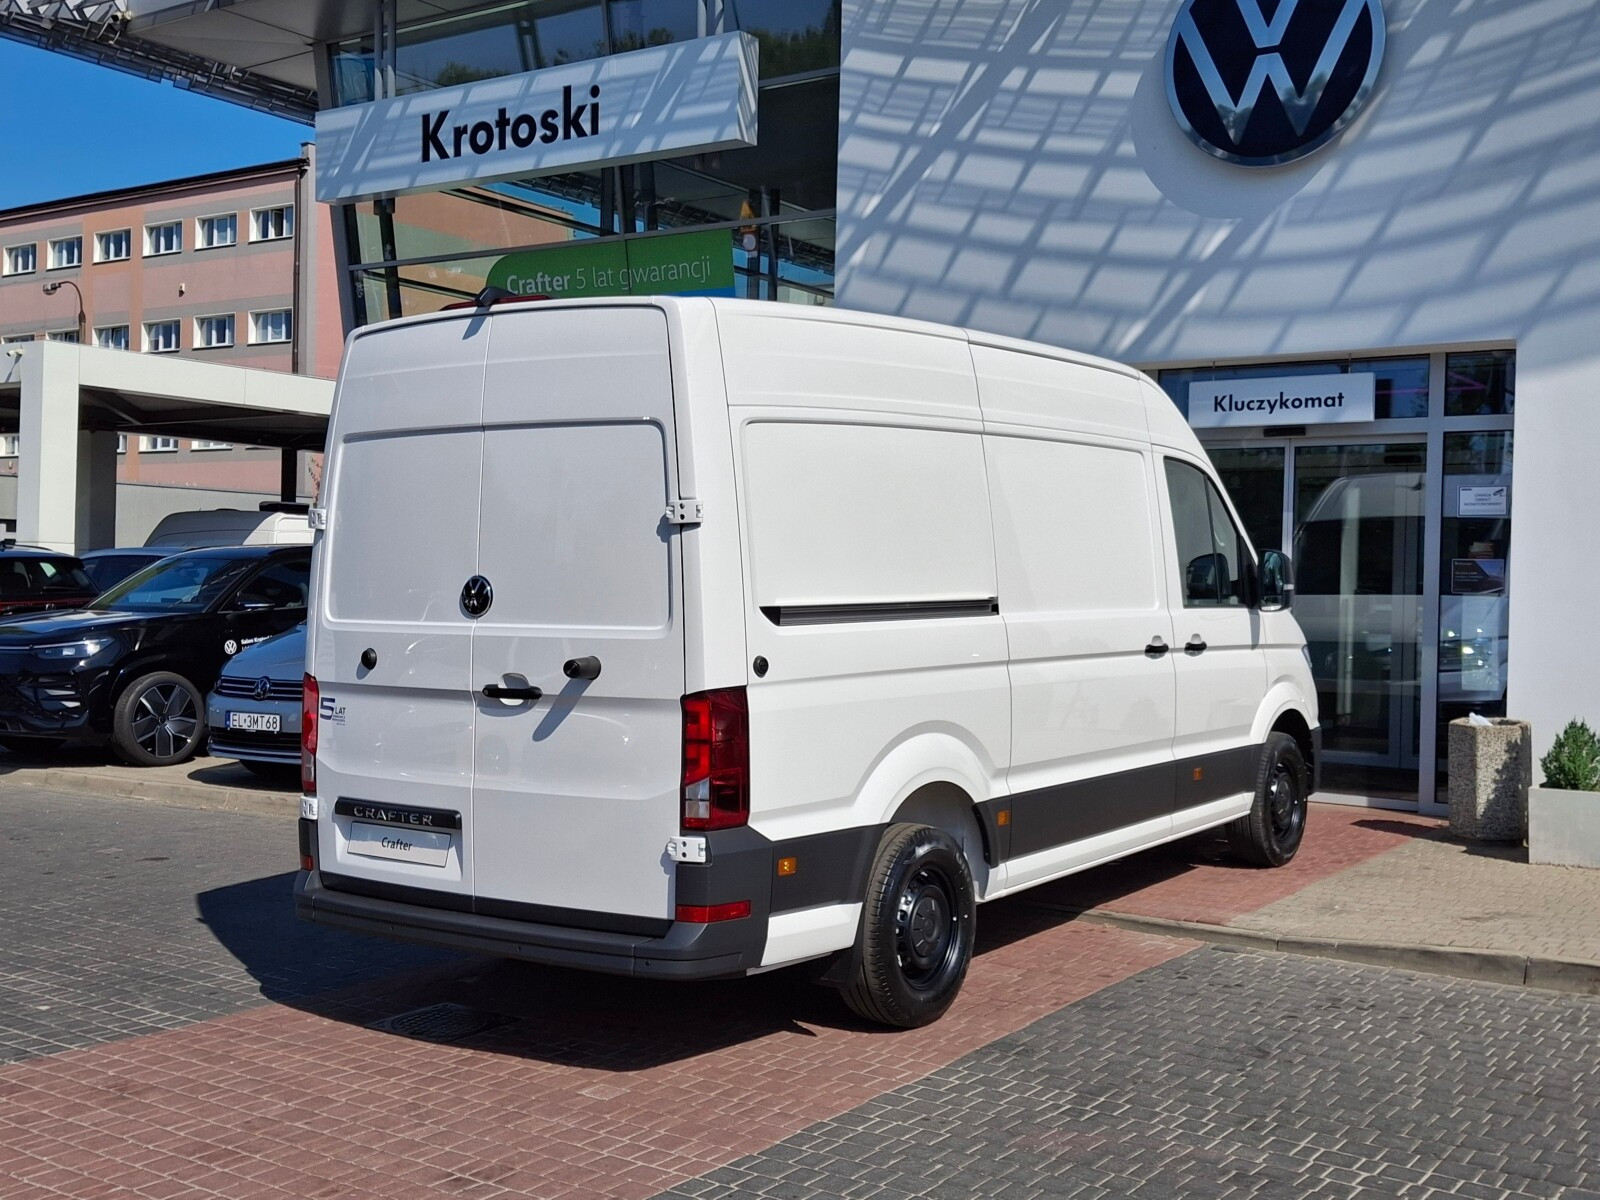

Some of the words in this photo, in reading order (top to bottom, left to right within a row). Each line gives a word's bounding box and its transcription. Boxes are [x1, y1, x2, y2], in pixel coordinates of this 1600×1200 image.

[421, 84, 600, 163] Krotoski
[506, 272, 570, 295] Crafter
[576, 268, 586, 289] 5
[592, 266, 614, 287] lat
[619, 256, 711, 290] gwarancji
[1213, 391, 1345, 414] Kluczykomat
[320, 697, 335, 720] 5
[335, 706, 346, 715] LAT
[247, 715, 278, 730] 3MT68
[353, 806, 432, 826] CRAFTER
[381, 837, 413, 851] Crafter
